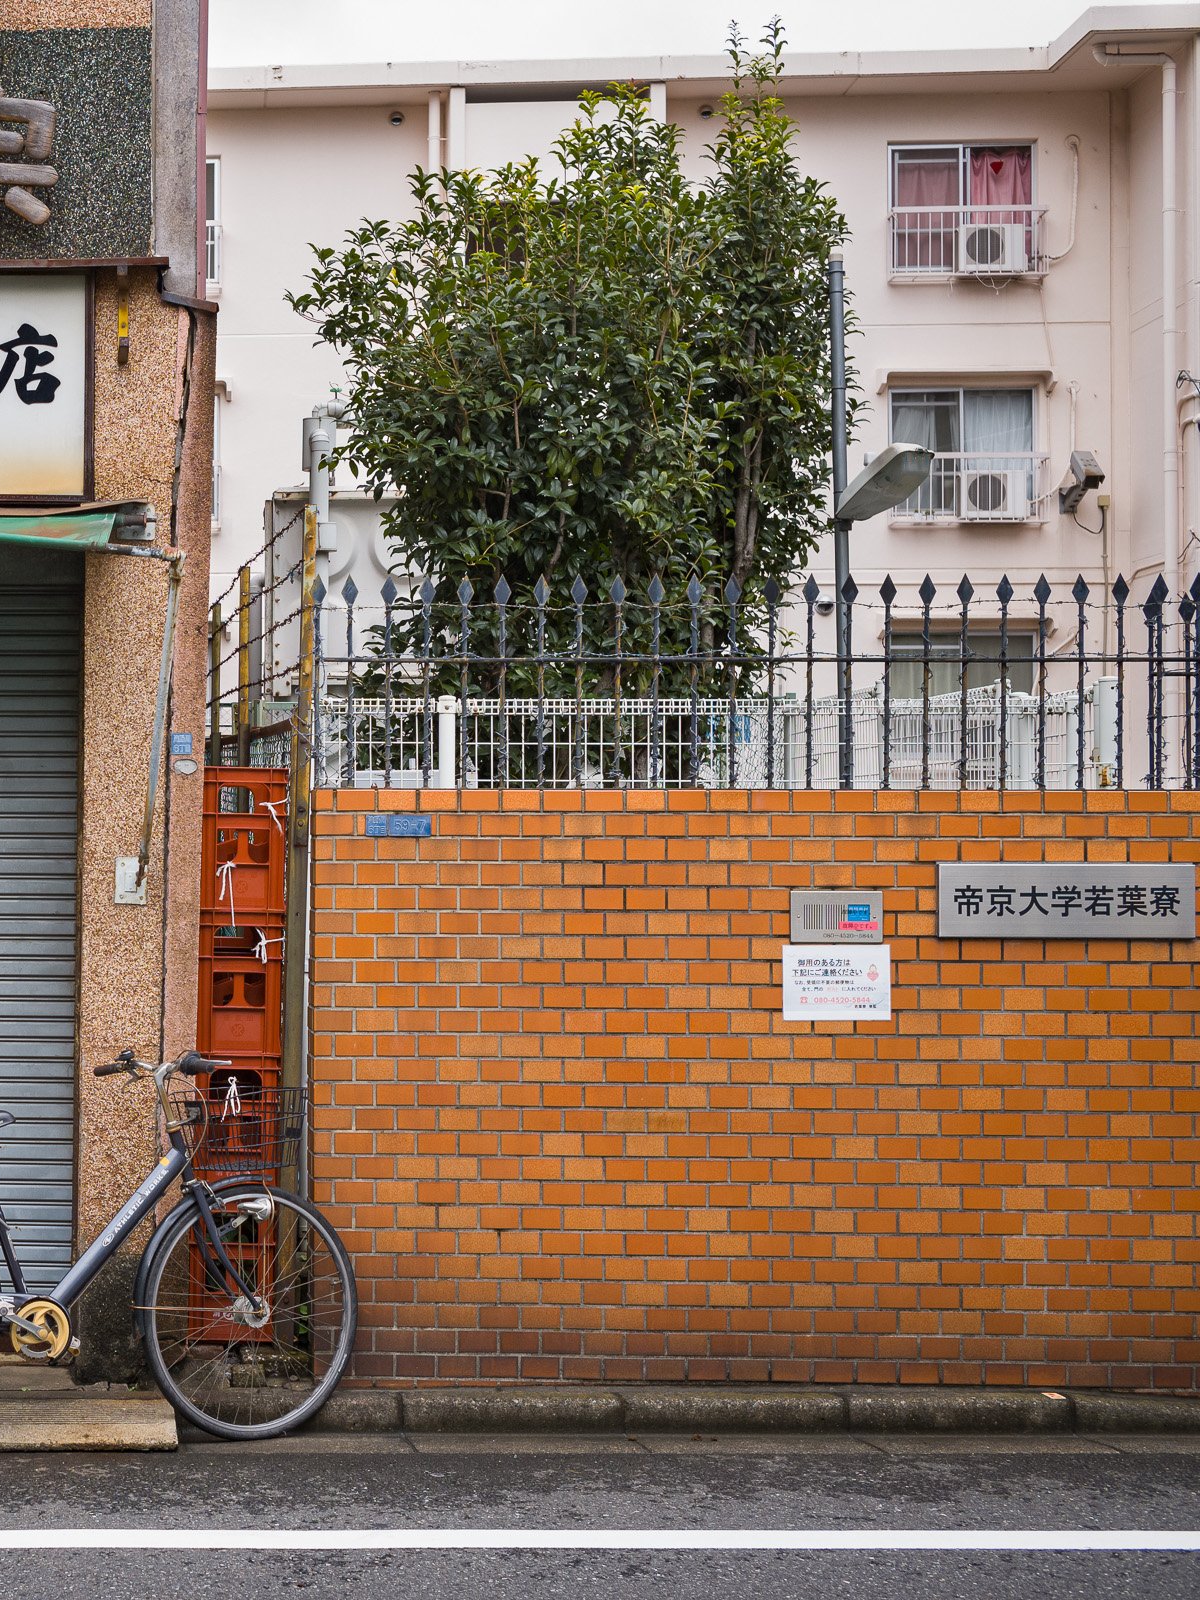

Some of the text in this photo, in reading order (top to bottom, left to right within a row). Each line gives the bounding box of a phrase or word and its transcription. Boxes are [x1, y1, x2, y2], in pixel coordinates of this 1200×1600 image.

[393, 818, 426, 833] 59-7
[953, 884, 1181, 918] 帝京大学若葉寮
[797, 958, 851, 967] 御用のある方は
[792, 968, 863, 977] 下記にご連絡ください
[114, 1198, 145, 1234] ATHLETIC
